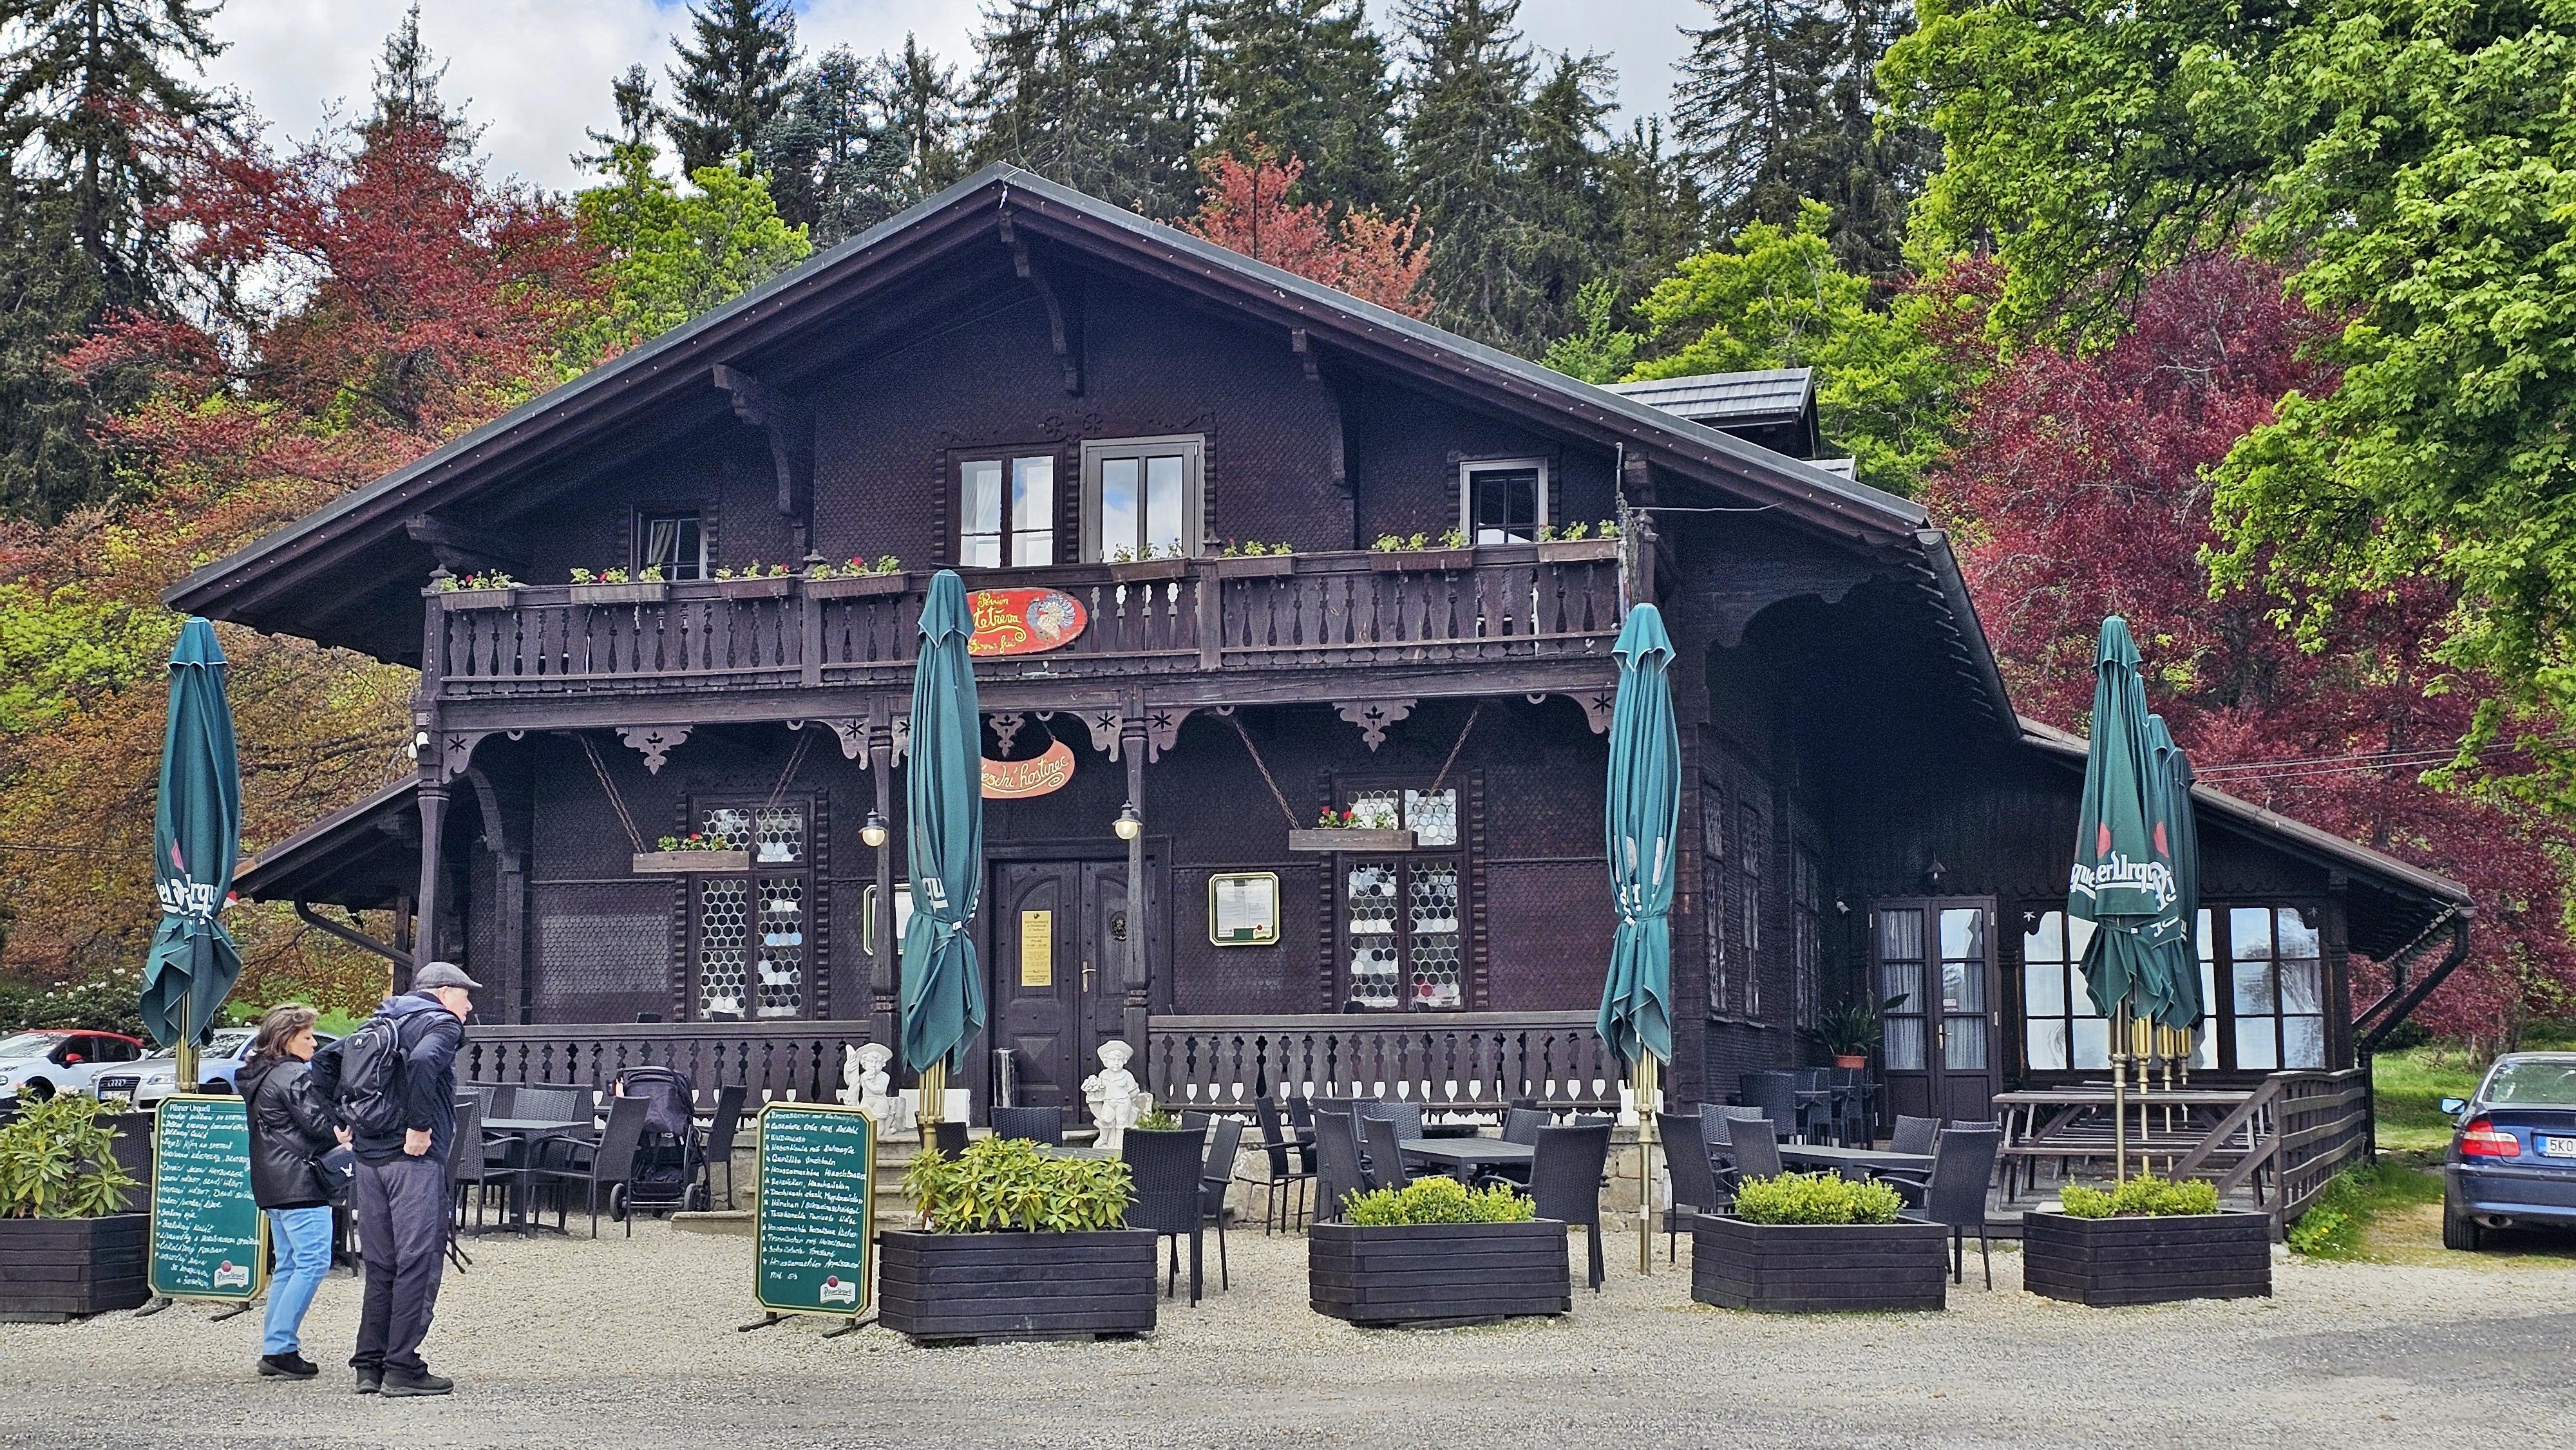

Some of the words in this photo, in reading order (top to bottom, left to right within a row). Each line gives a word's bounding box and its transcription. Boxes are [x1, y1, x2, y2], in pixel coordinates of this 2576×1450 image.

[1020, 756, 1068, 787] hostinec
[169, 1104, 189, 1112] Pilsner
[189, 1104, 211, 1114] Urquell
